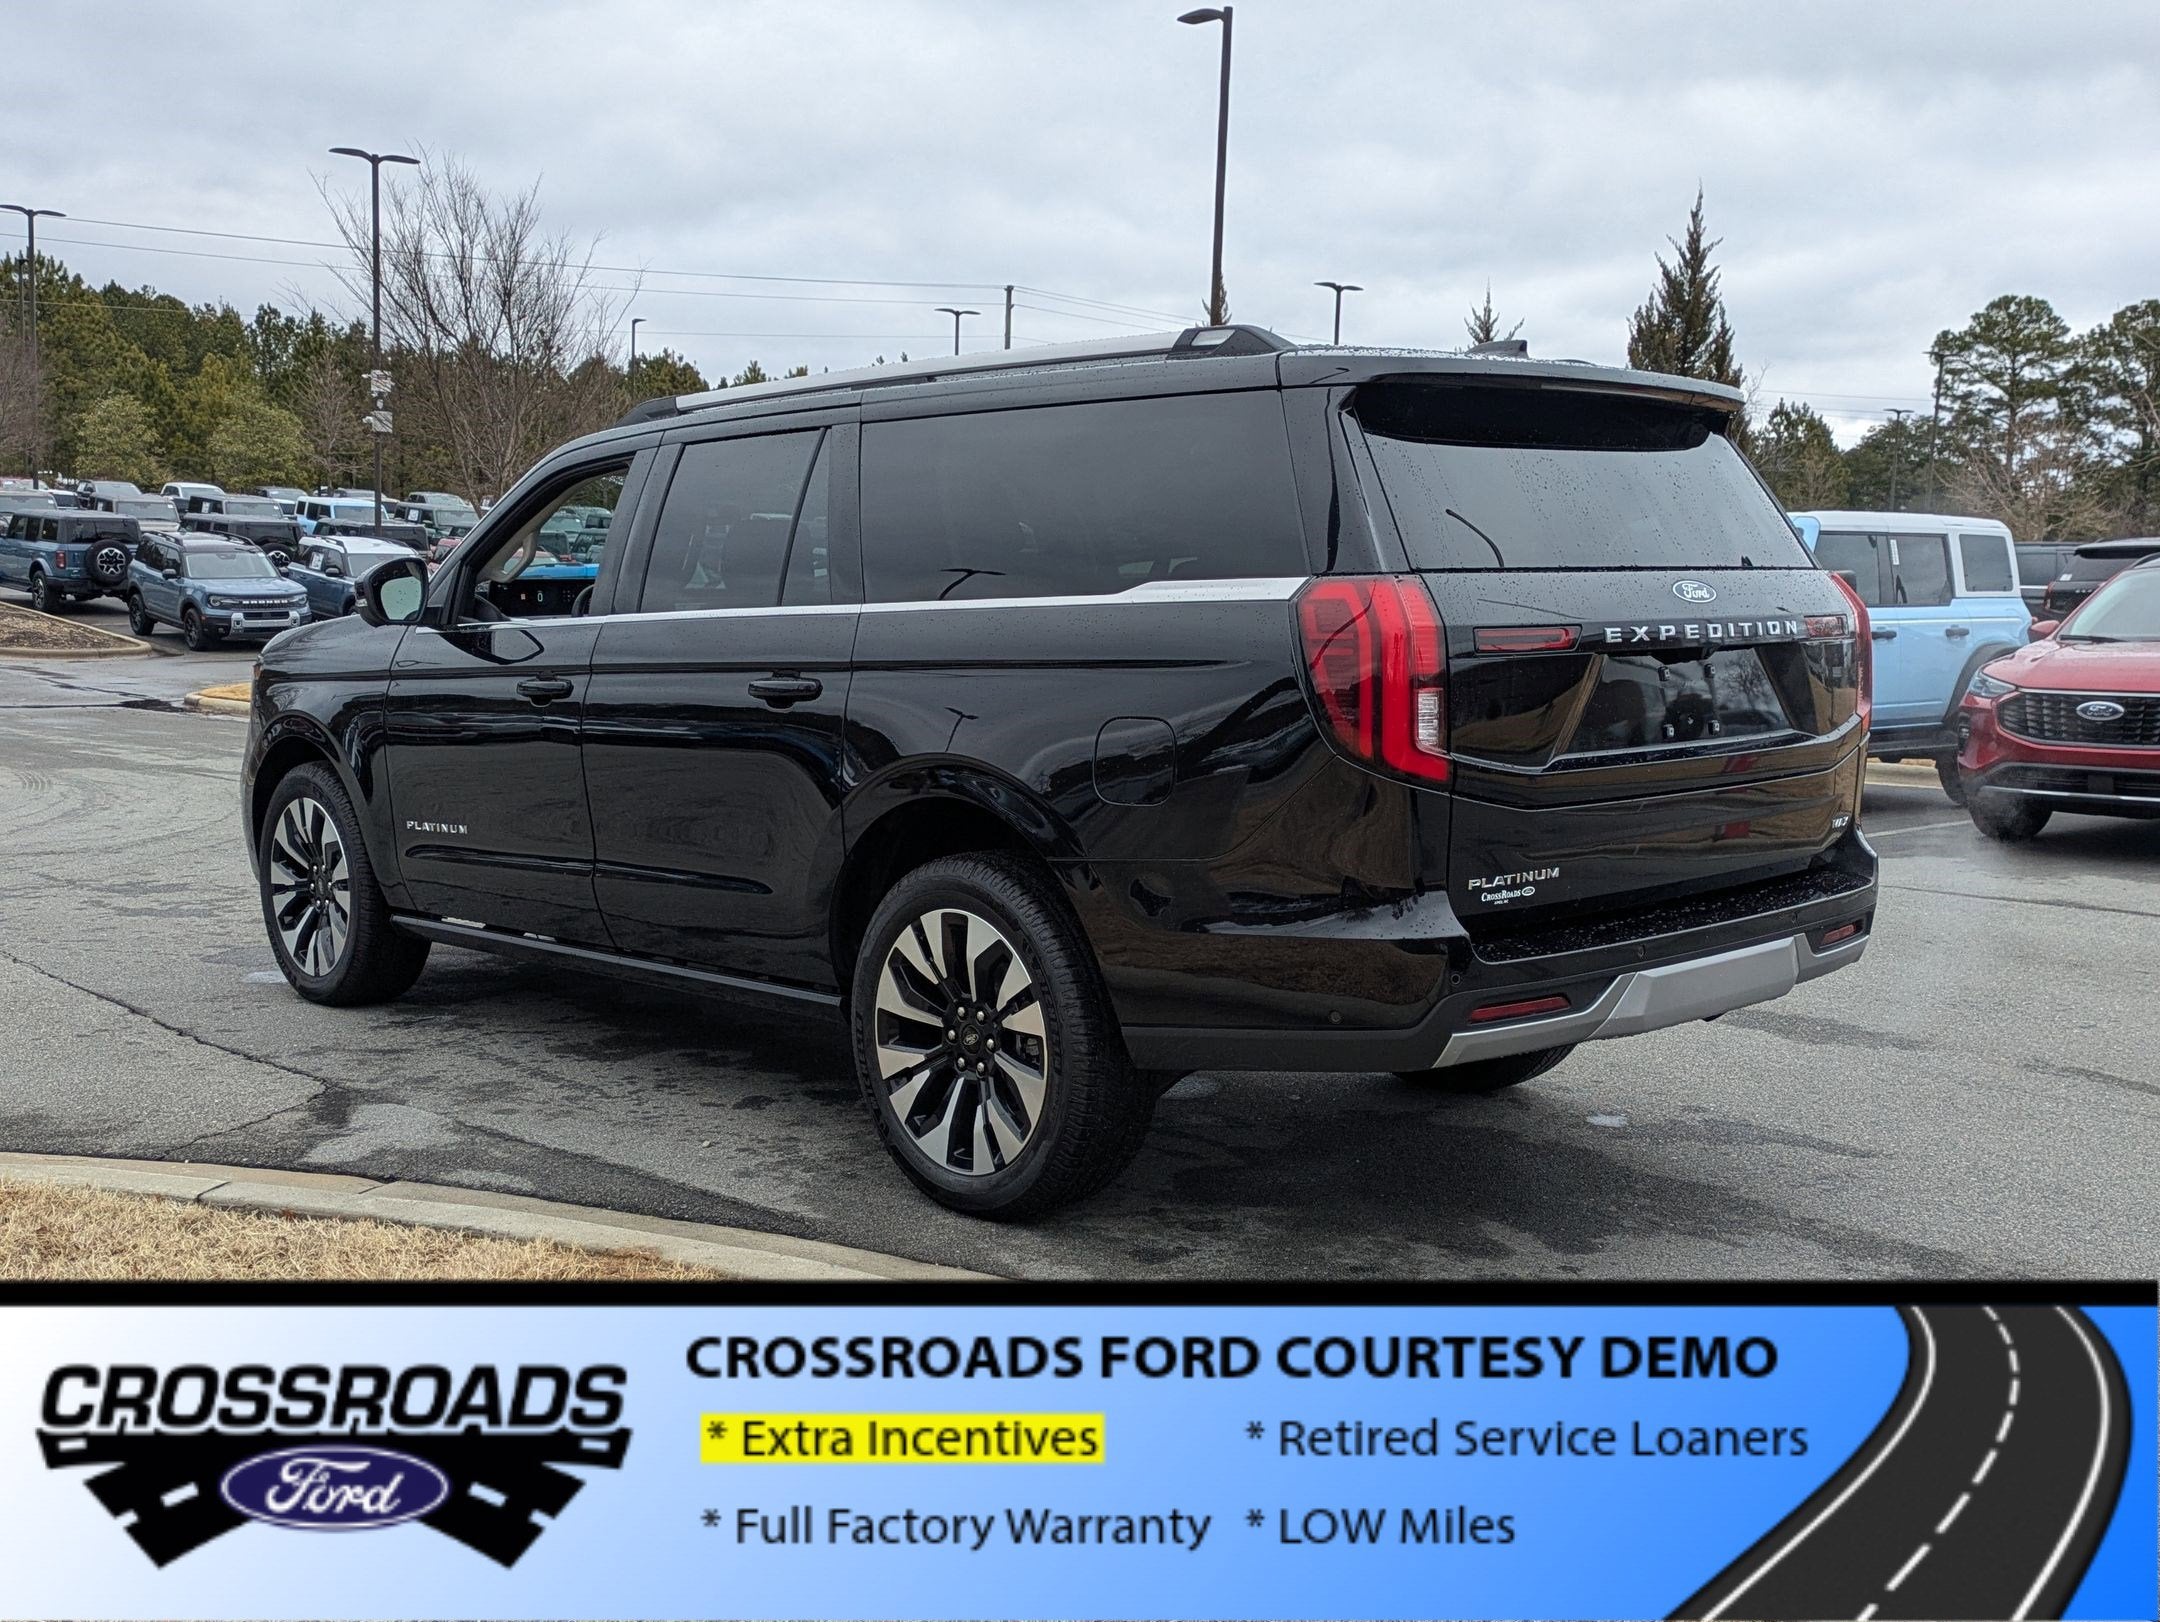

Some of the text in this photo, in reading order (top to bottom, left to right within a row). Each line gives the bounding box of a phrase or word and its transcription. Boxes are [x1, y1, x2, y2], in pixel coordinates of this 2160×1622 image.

[1604, 620, 1798, 644] EXPEDITION
[406, 820, 468, 835] PLATINUM
[1467, 866, 1560, 891] PLATINUM
